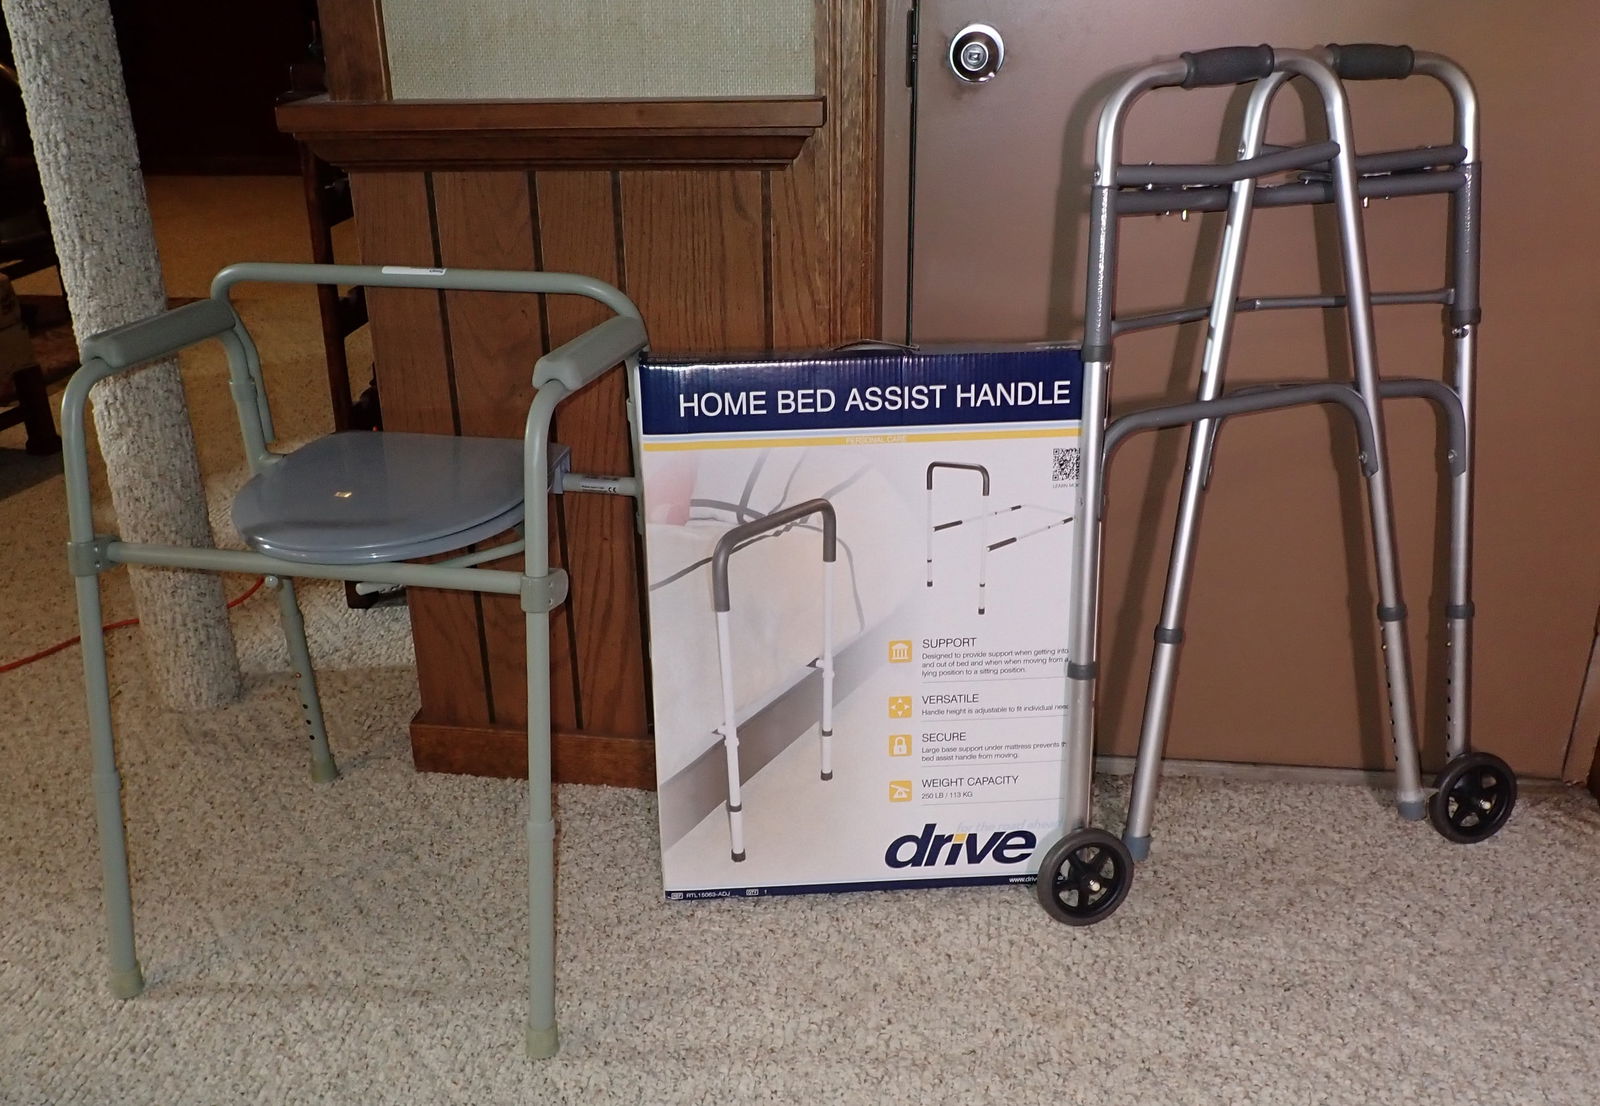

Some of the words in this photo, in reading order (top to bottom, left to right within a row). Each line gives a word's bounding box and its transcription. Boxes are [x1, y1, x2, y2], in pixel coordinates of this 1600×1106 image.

[680, 391, 767, 418] HOME
[777, 388, 836, 414] BED
[844, 385, 946, 412] ASSIST
[956, 380, 1070, 408] HANDLE
[887, 434, 907, 443] CARE
[922, 637, 977, 649] SUPPORT
[922, 653, 953, 661] Designed
[963, 652, 987, 660] provide
[988, 651, 1013, 659] support
[1034, 649, 1055, 658] getting
[985, 659, 1002, 667] when
[1004, 658, 1022, 666] when
[1023, 658, 1047, 666] moving
[922, 670, 937, 678] lying
[939, 669, 964, 678] position
[979, 669, 998, 677] sitting
[922, 694, 980, 705] VERSATILE
[946, 708, 966, 717] height
[974, 707, 1007, 716] adjustable
[922, 732, 967, 743] SECURE
[922, 747, 940, 755] Large
[958, 745, 983, 754] support
[1005, 743, 1031, 751] mattress
[1033, 742, 1060, 750] prevents
[922, 778, 964, 788] WEIGHT
[966, 776, 1019, 787] CAPACITY
[885, 823, 1037, 869] drive
